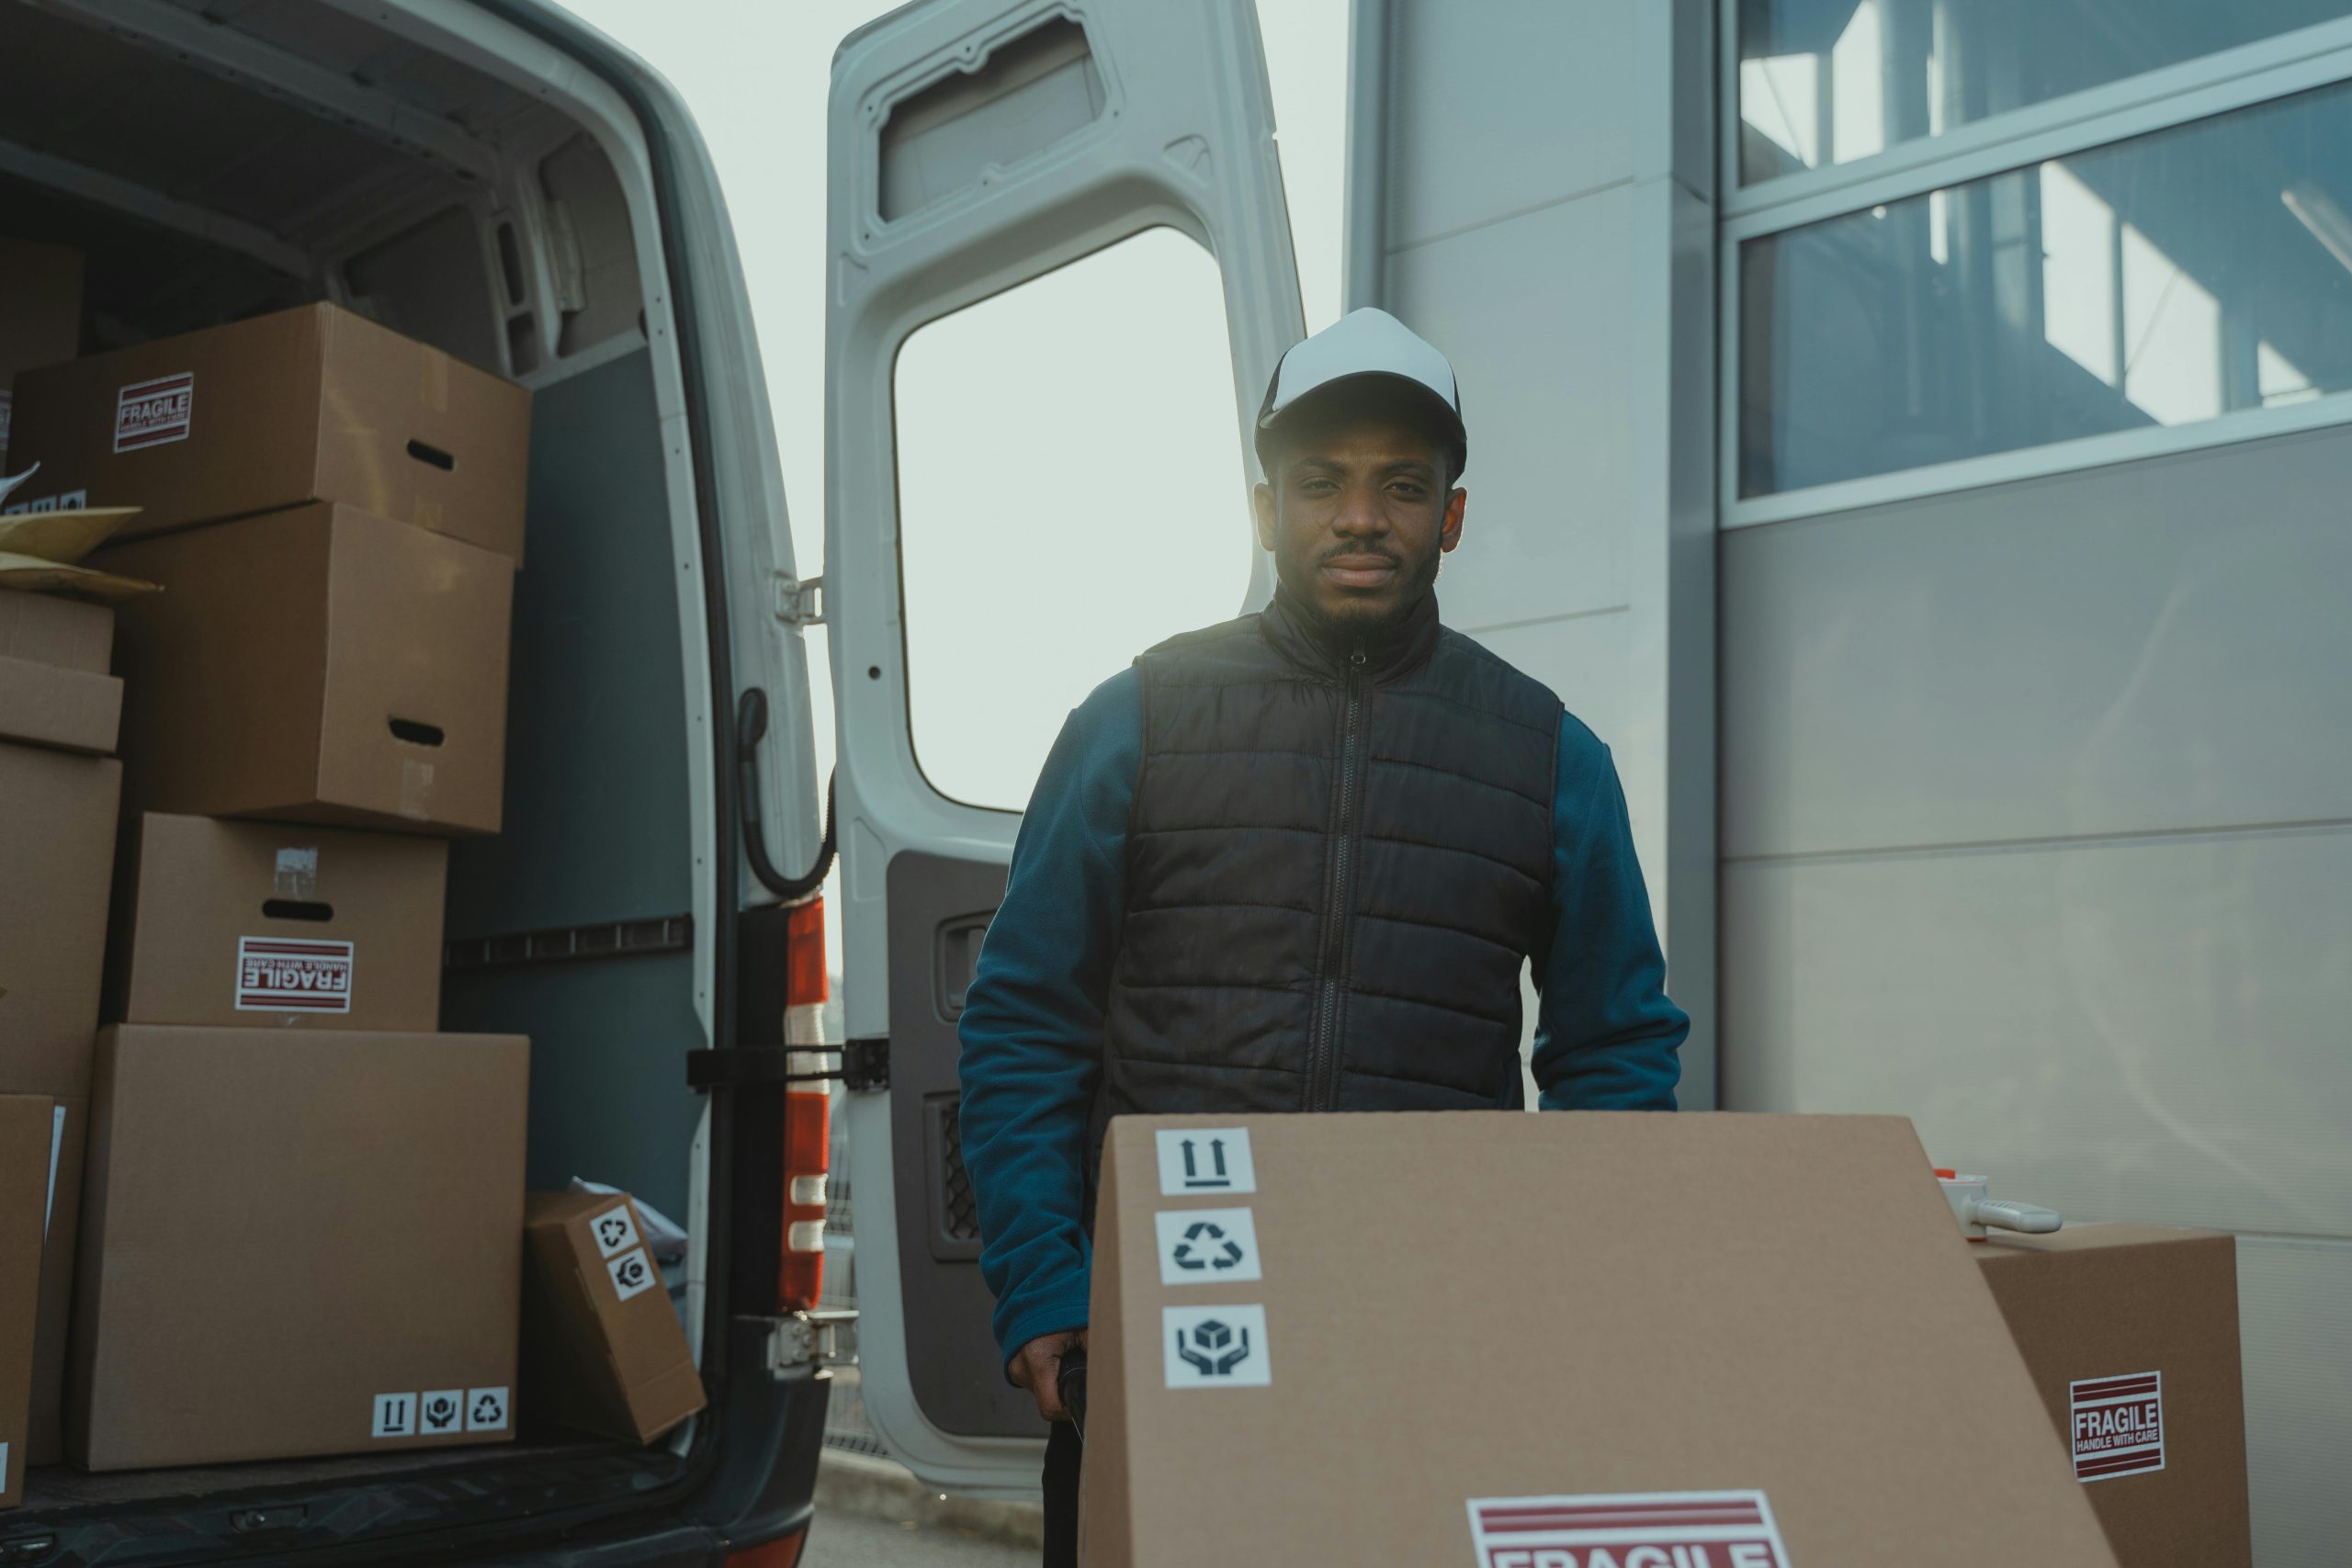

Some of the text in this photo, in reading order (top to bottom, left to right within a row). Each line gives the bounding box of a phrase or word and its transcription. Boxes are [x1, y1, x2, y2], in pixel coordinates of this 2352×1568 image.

[120, 394, 188, 424] FRAGILE
[244, 968, 347, 990] FRAGILE
[2075, 1403, 2158, 1439] FRAGILE
[2076, 1428, 2158, 1452] HANDLE WITH CARE
